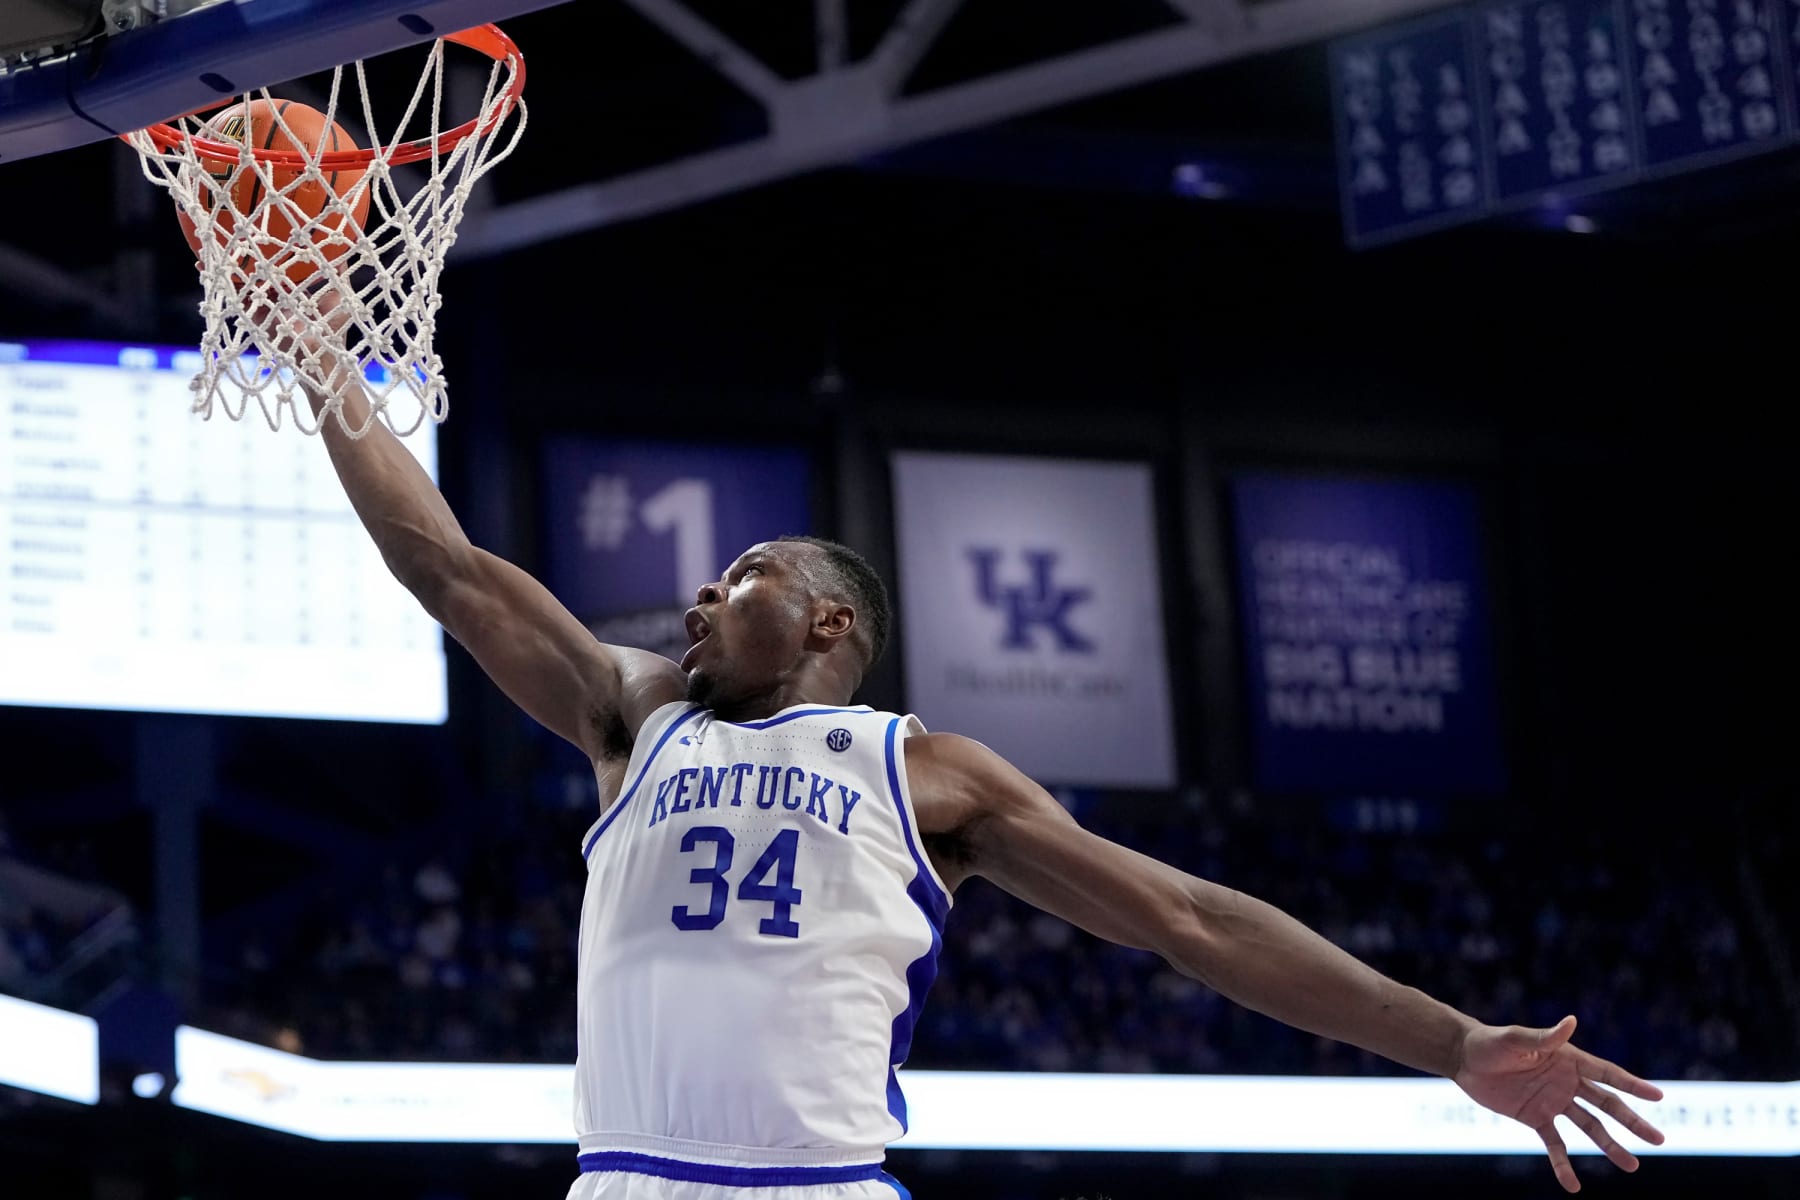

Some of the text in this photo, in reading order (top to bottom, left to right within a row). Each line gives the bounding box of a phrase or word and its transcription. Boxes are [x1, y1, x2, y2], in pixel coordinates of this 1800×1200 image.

[1487, 7, 1532, 155] NCAA
[577, 474, 717, 606] #1
[1264, 645, 1459, 693] BIG BLUE
[828, 730, 852, 750] SEC
[1267, 689, 1443, 731] NATION
[648, 762, 862, 836] KENTUCKY
[671, 826, 803, 939] 34
